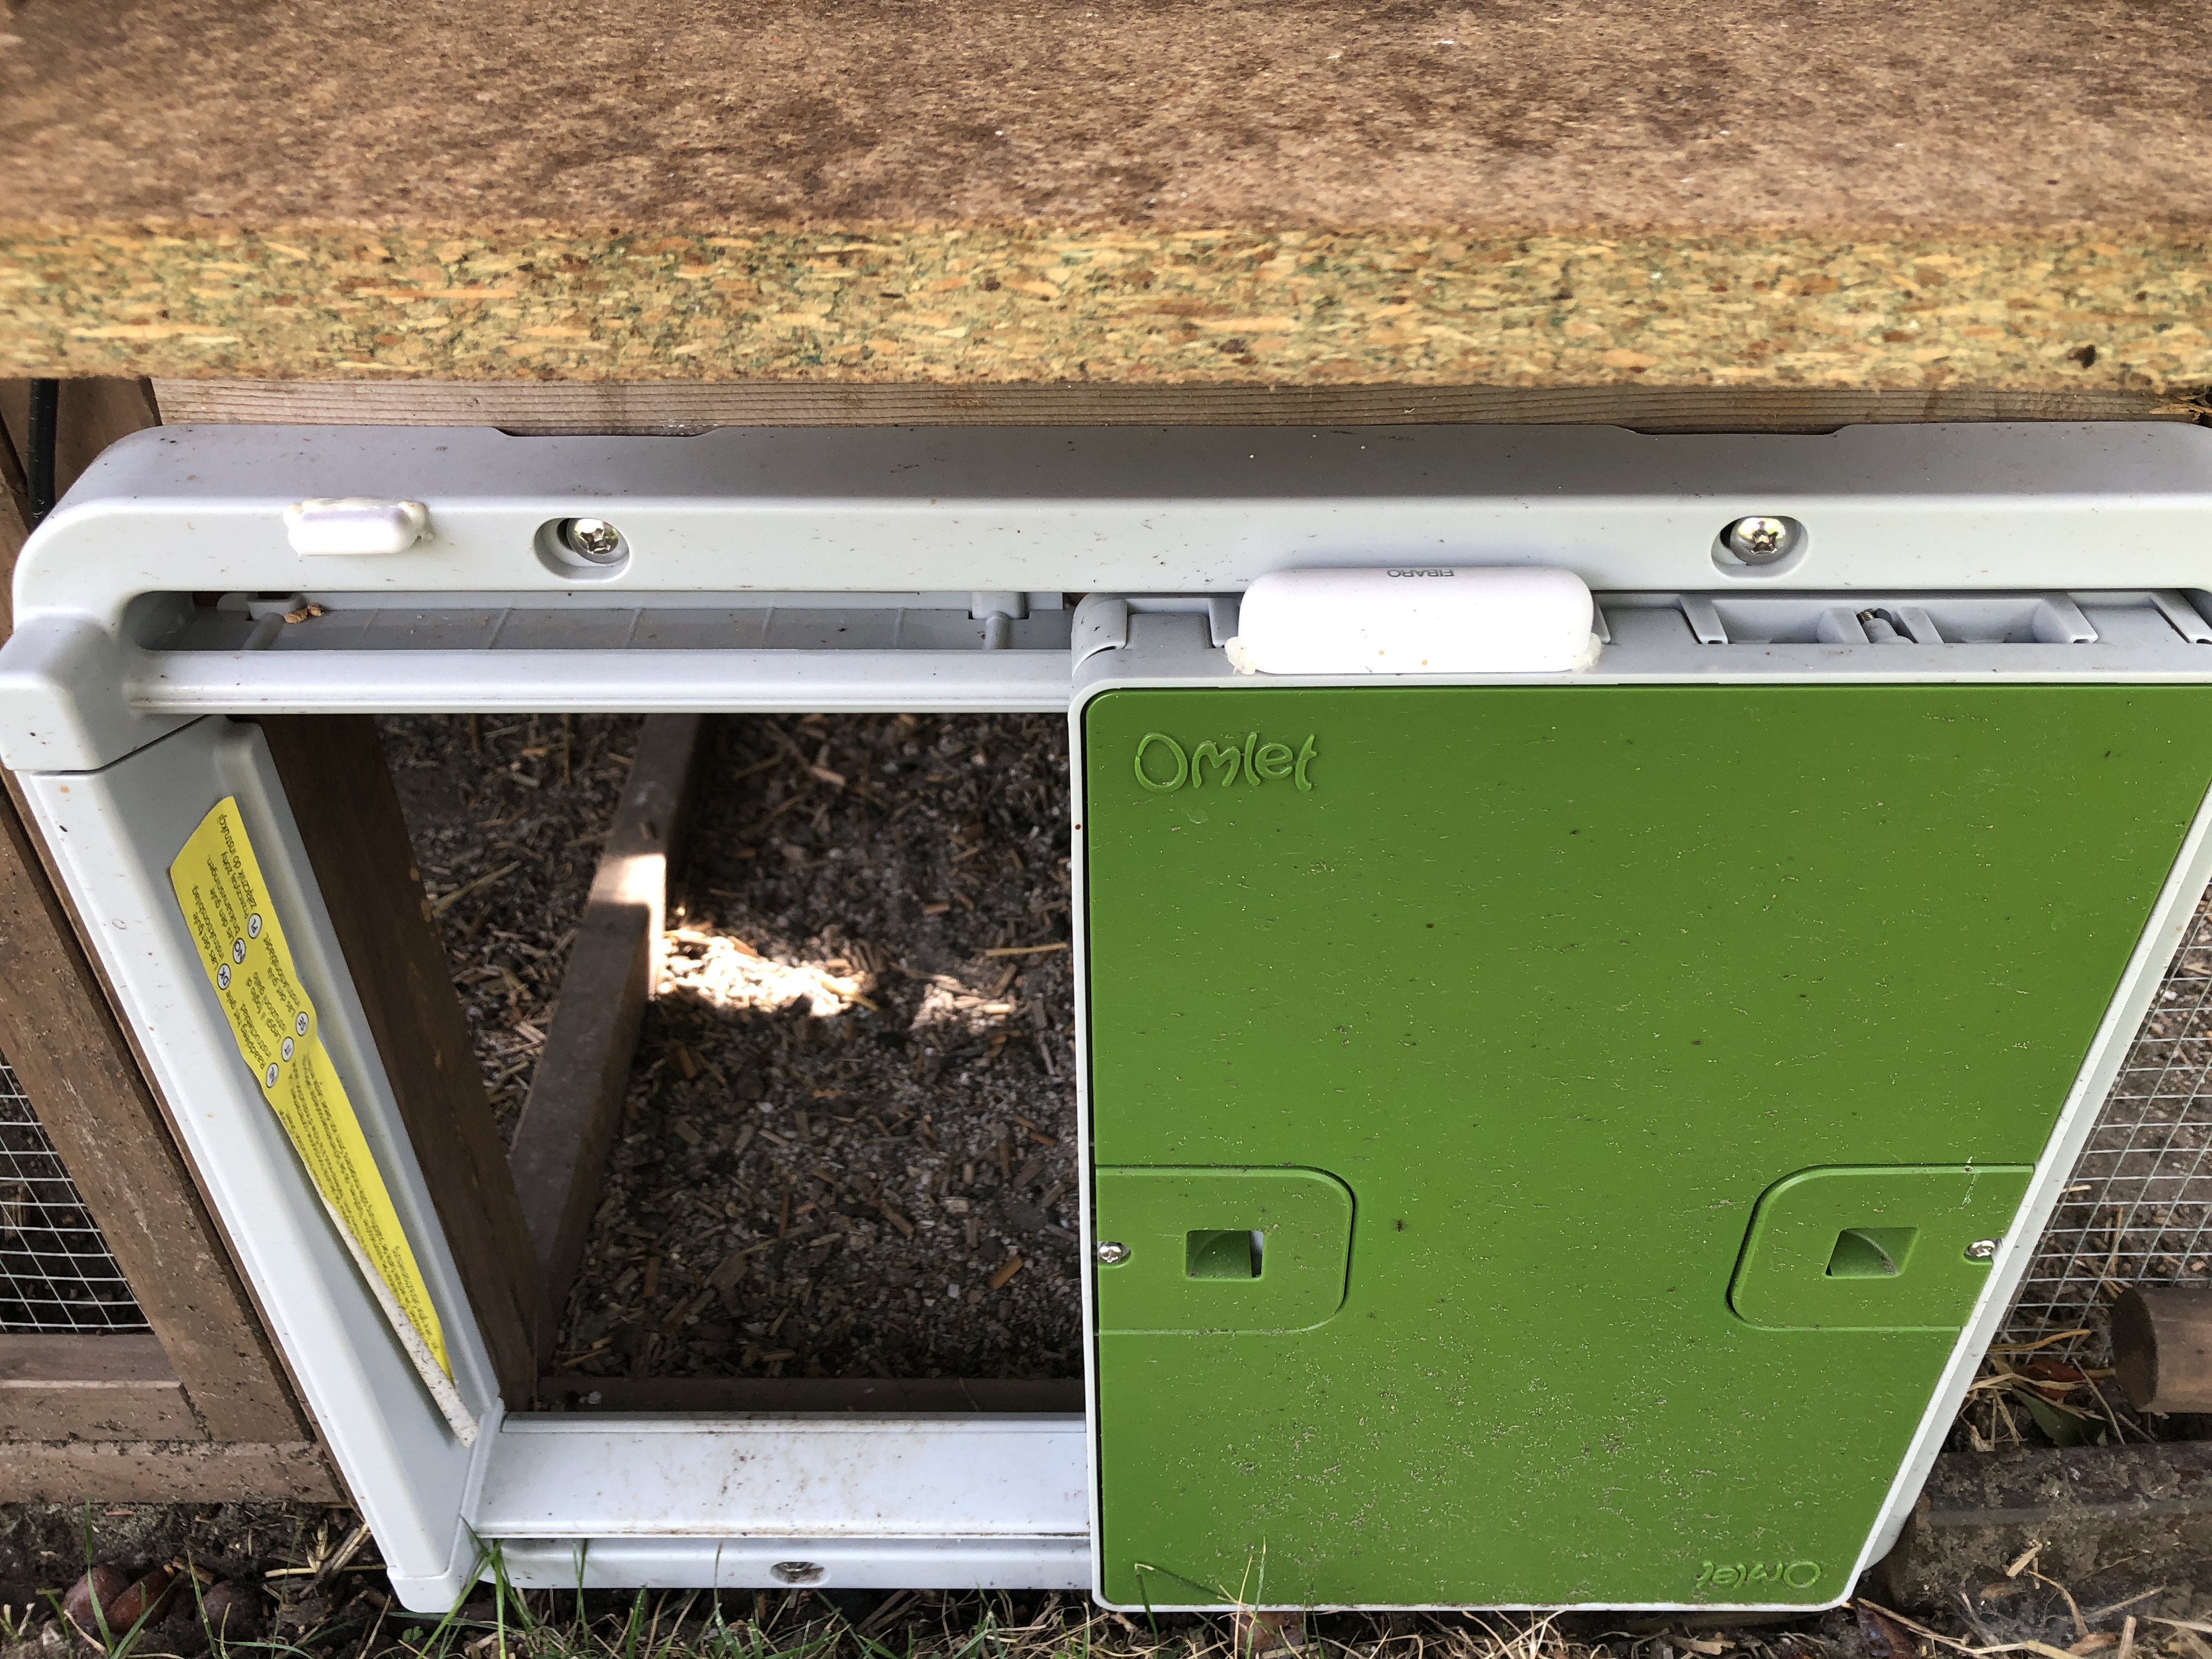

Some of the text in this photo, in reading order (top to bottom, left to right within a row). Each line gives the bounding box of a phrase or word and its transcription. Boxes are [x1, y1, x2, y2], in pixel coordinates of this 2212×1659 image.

[1387, 569, 1454, 578] FIBARO
[1135, 732, 1317, 793] Omlet
[233, 856, 241, 869] do
[210, 887, 235, 945] Les den gule
[251, 918, 258, 934] PL
[202, 933, 211, 950] det
[209, 950, 218, 971] Læs
[235, 941, 245, 962] NO
[219, 967, 229, 986] DK
[276, 986, 286, 1002] det
[234, 1008, 242, 1027] het
[298, 1016, 306, 1031] SE
[240, 1023, 267, 1070] Raadpleeg
[1696, 1561, 1821, 1589] Omlet
